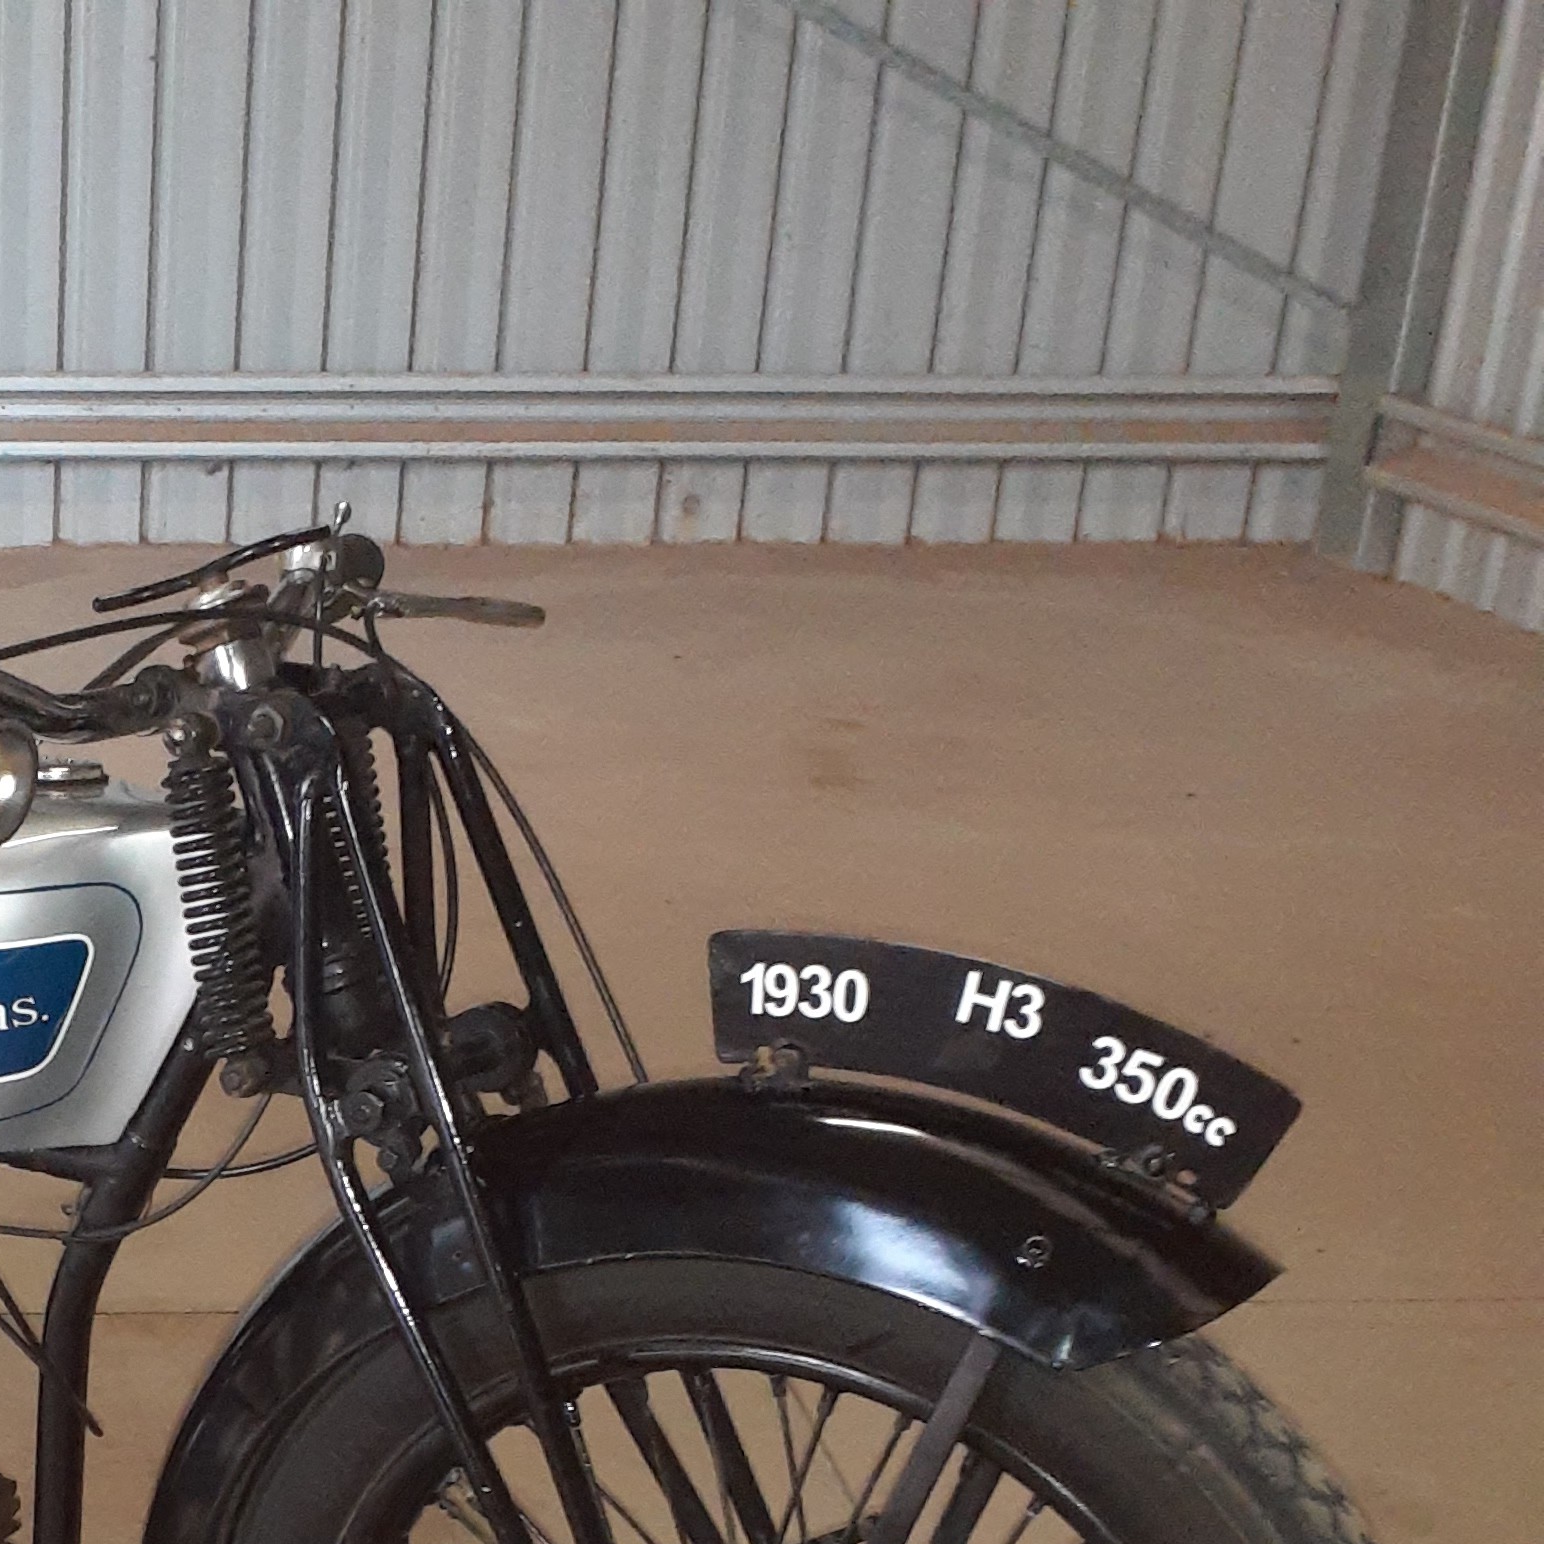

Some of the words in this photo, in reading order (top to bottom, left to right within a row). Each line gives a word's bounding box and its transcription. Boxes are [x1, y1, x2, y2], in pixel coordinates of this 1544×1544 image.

[740, 962, 869, 1023] 1930
[955, 970, 1045, 1039] H3
[1078, 1036, 1236, 1147] 350cc
